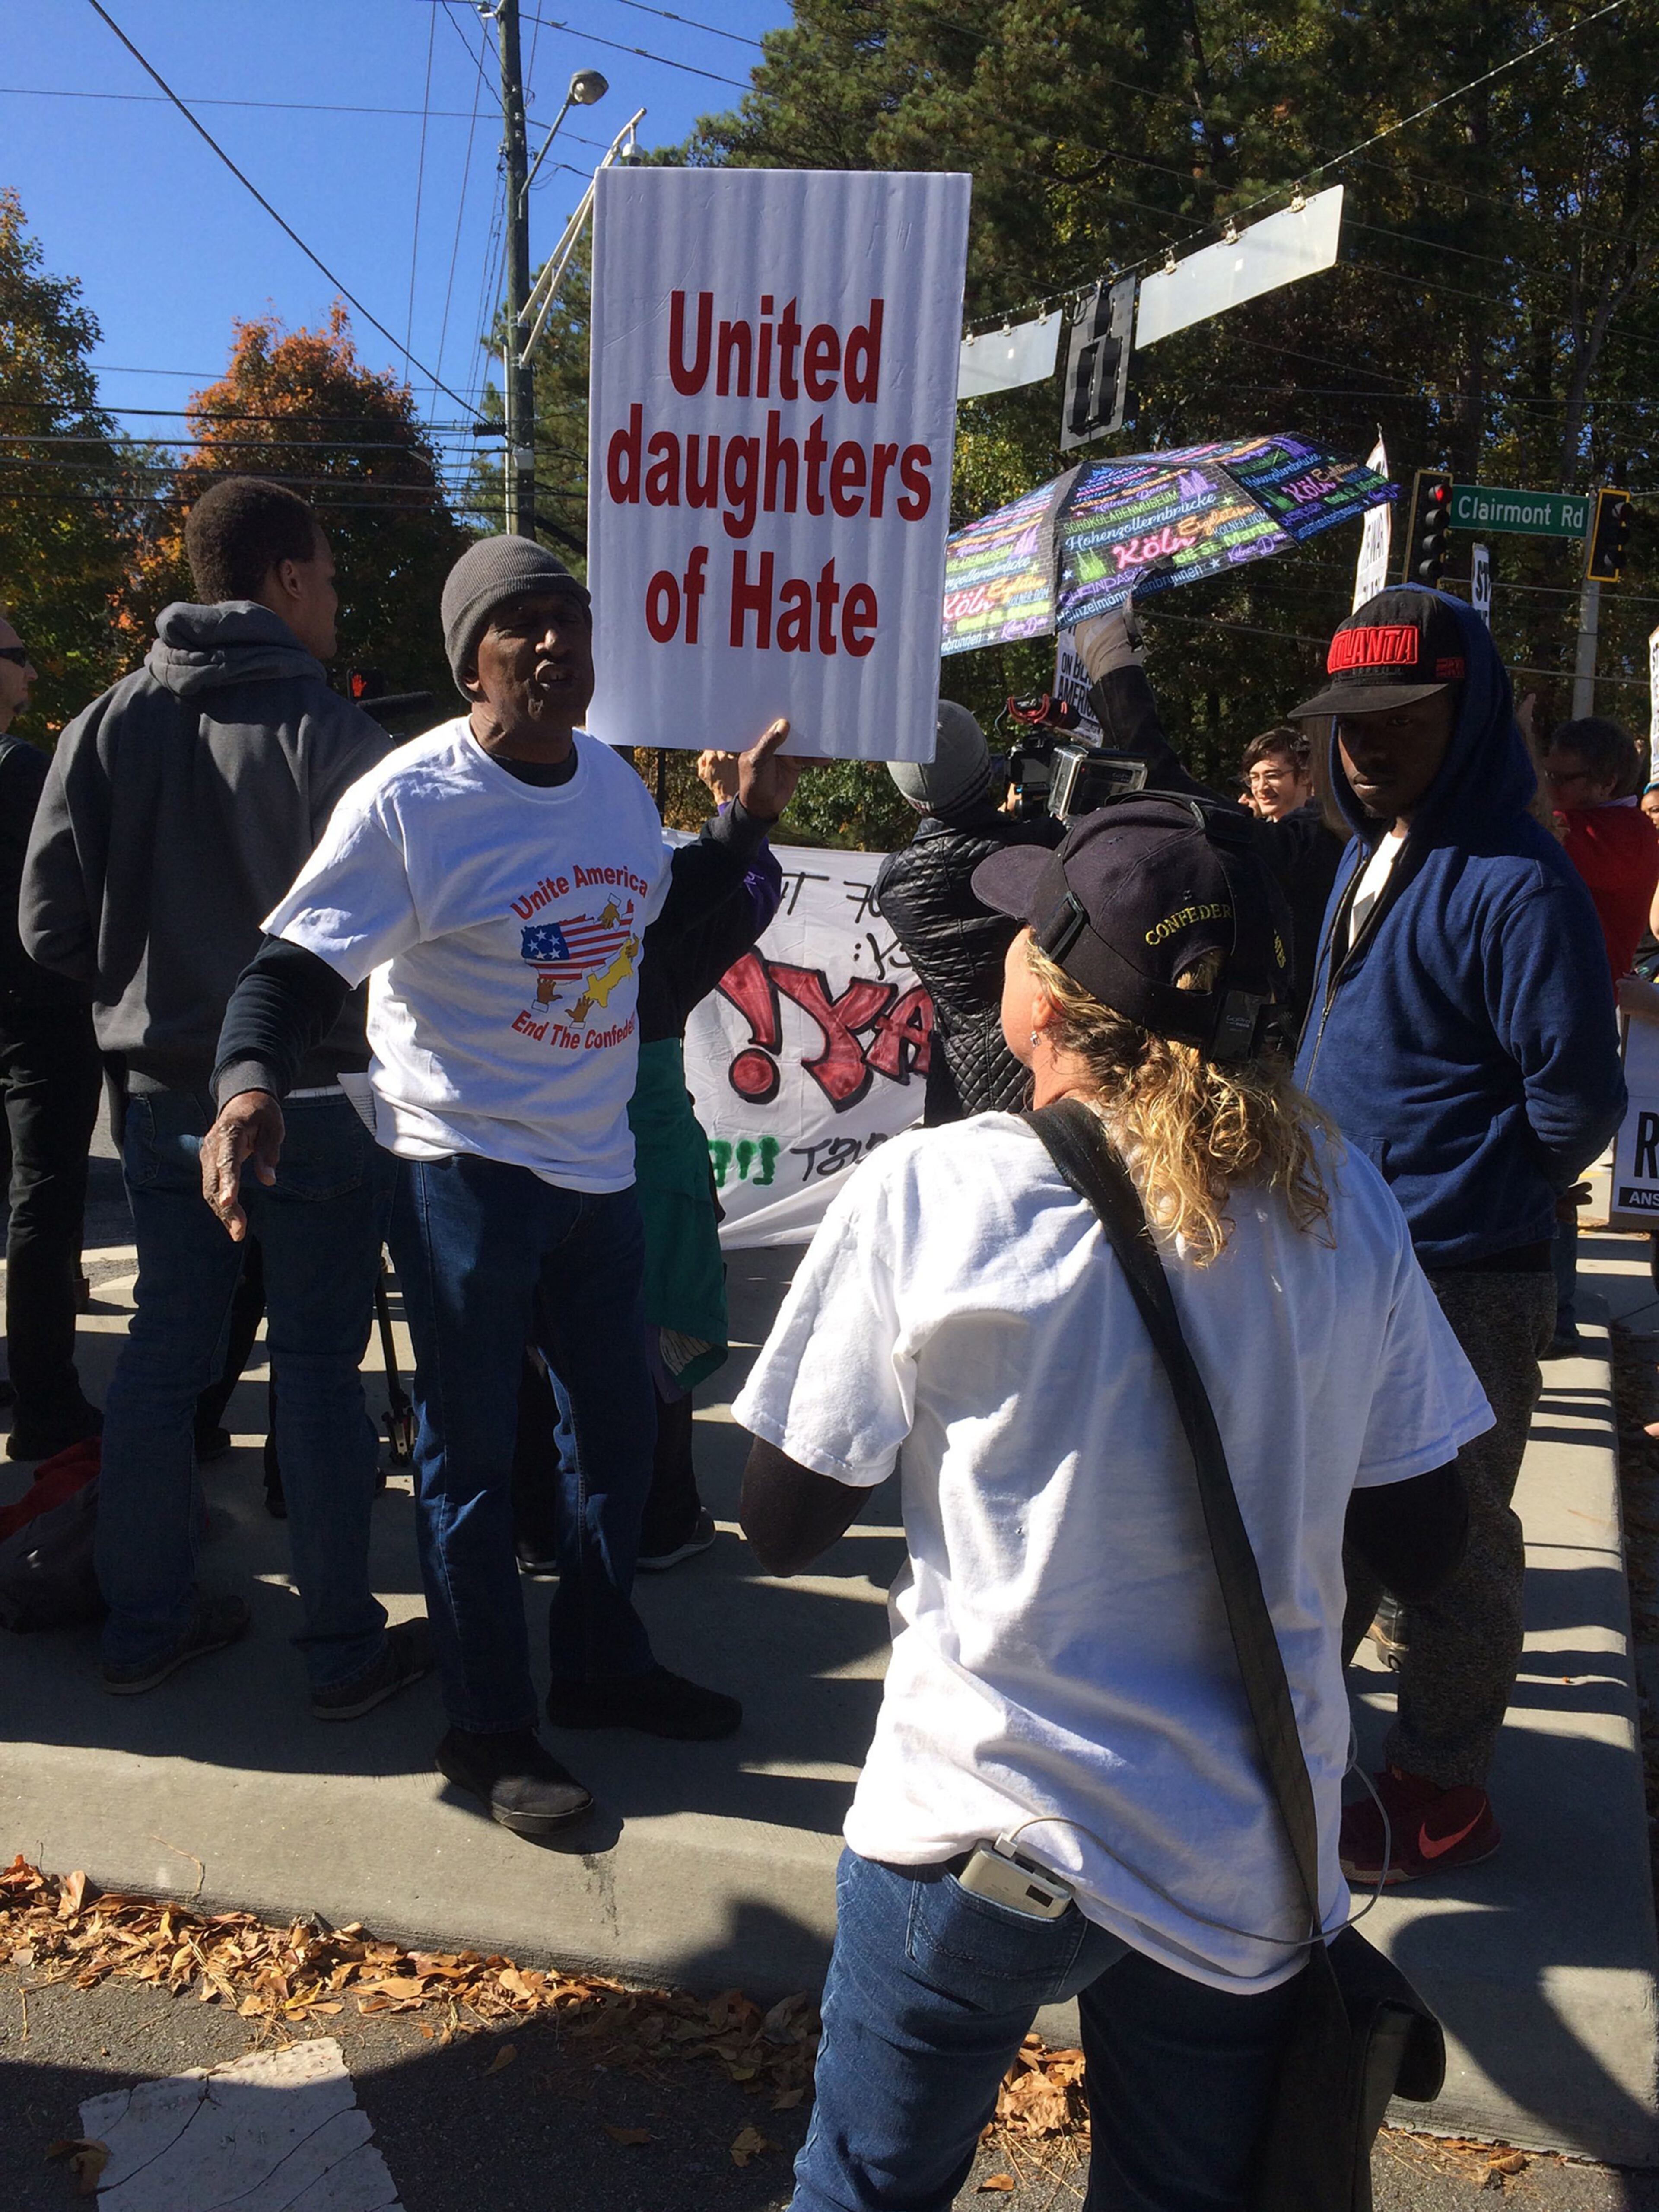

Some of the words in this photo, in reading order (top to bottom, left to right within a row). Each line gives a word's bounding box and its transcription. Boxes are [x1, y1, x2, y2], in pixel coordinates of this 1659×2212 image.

[669, 290, 885, 404] United
[607, 403, 931, 539] daughters
[1281, 475, 1337, 503] Köln
[1063, 490, 1179, 535] SCHOKOLADENMUSEUM
[1065, 493, 1217, 551] Hohenzollernbrücke
[1222, 521, 1280, 547] Martin
[1458, 496, 1551, 525] Clairmont
[1561, 504, 1584, 528] Rd
[1113, 527, 1196, 570] Köln
[645, 546, 708, 644] of
[730, 550, 878, 657] Hate
[1061, 652, 1073, 676] ON
[510, 877, 570, 920] Unite
[573, 865, 648, 898] America
[511, 1010, 549, 1041] End
[550, 1024, 580, 1049] The
